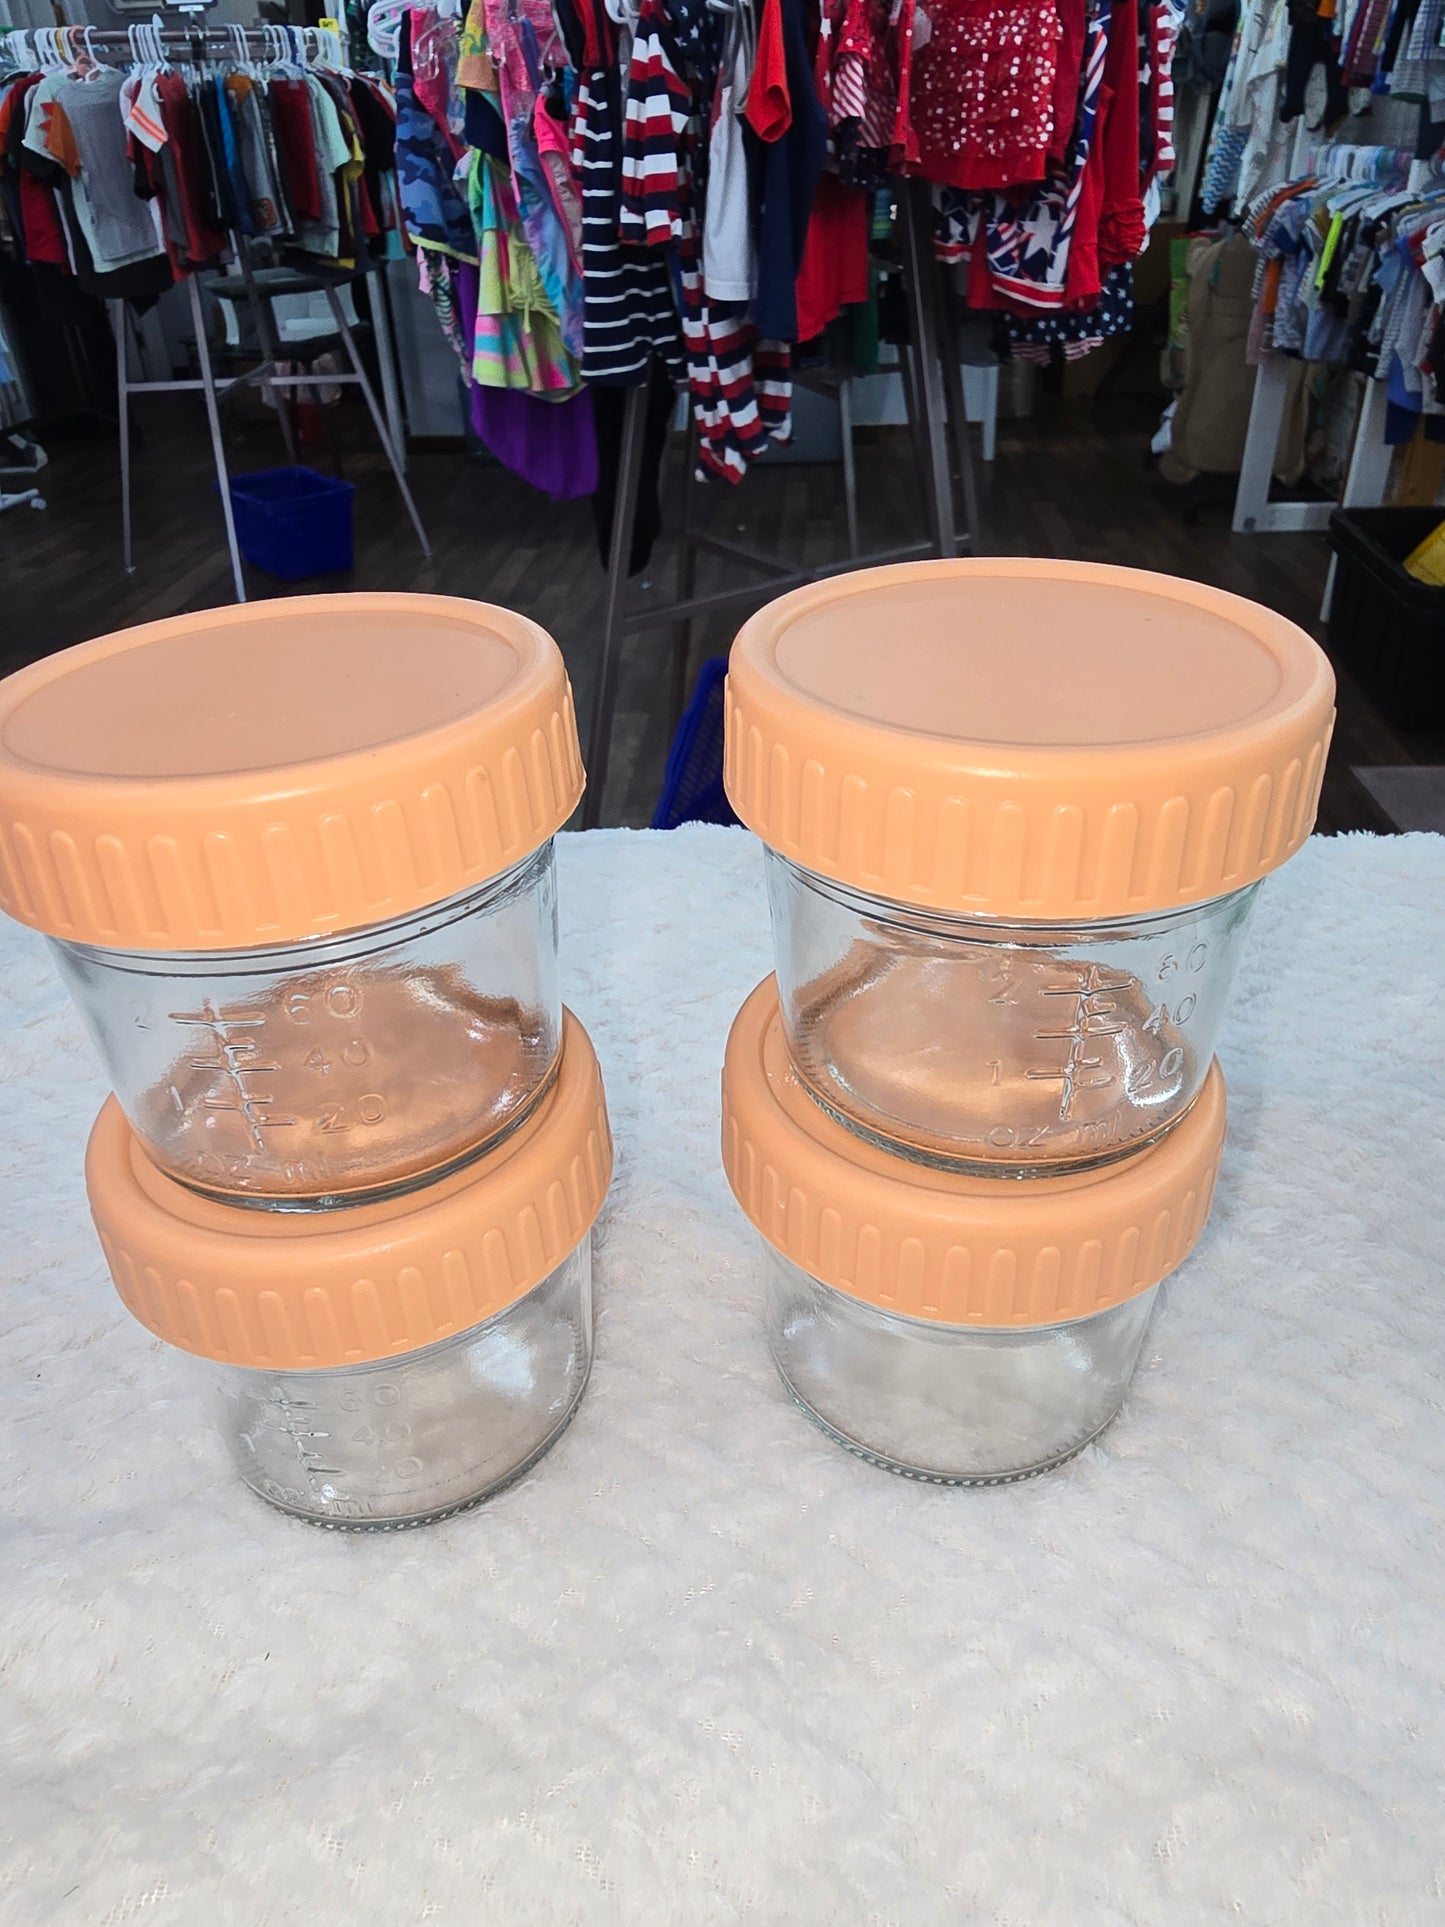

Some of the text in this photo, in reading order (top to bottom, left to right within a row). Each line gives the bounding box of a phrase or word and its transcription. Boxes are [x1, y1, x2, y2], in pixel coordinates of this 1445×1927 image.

[1158, 942, 1209, 980] 60
[283, 984, 364, 1025] 60
[1143, 992, 1197, 1035] 40
[303, 1038, 373, 1075] 40
[985, 1059, 1001, 1086] 1
[1127, 1047, 1184, 1093] 20
[316, 1093, 388, 1134] 20
